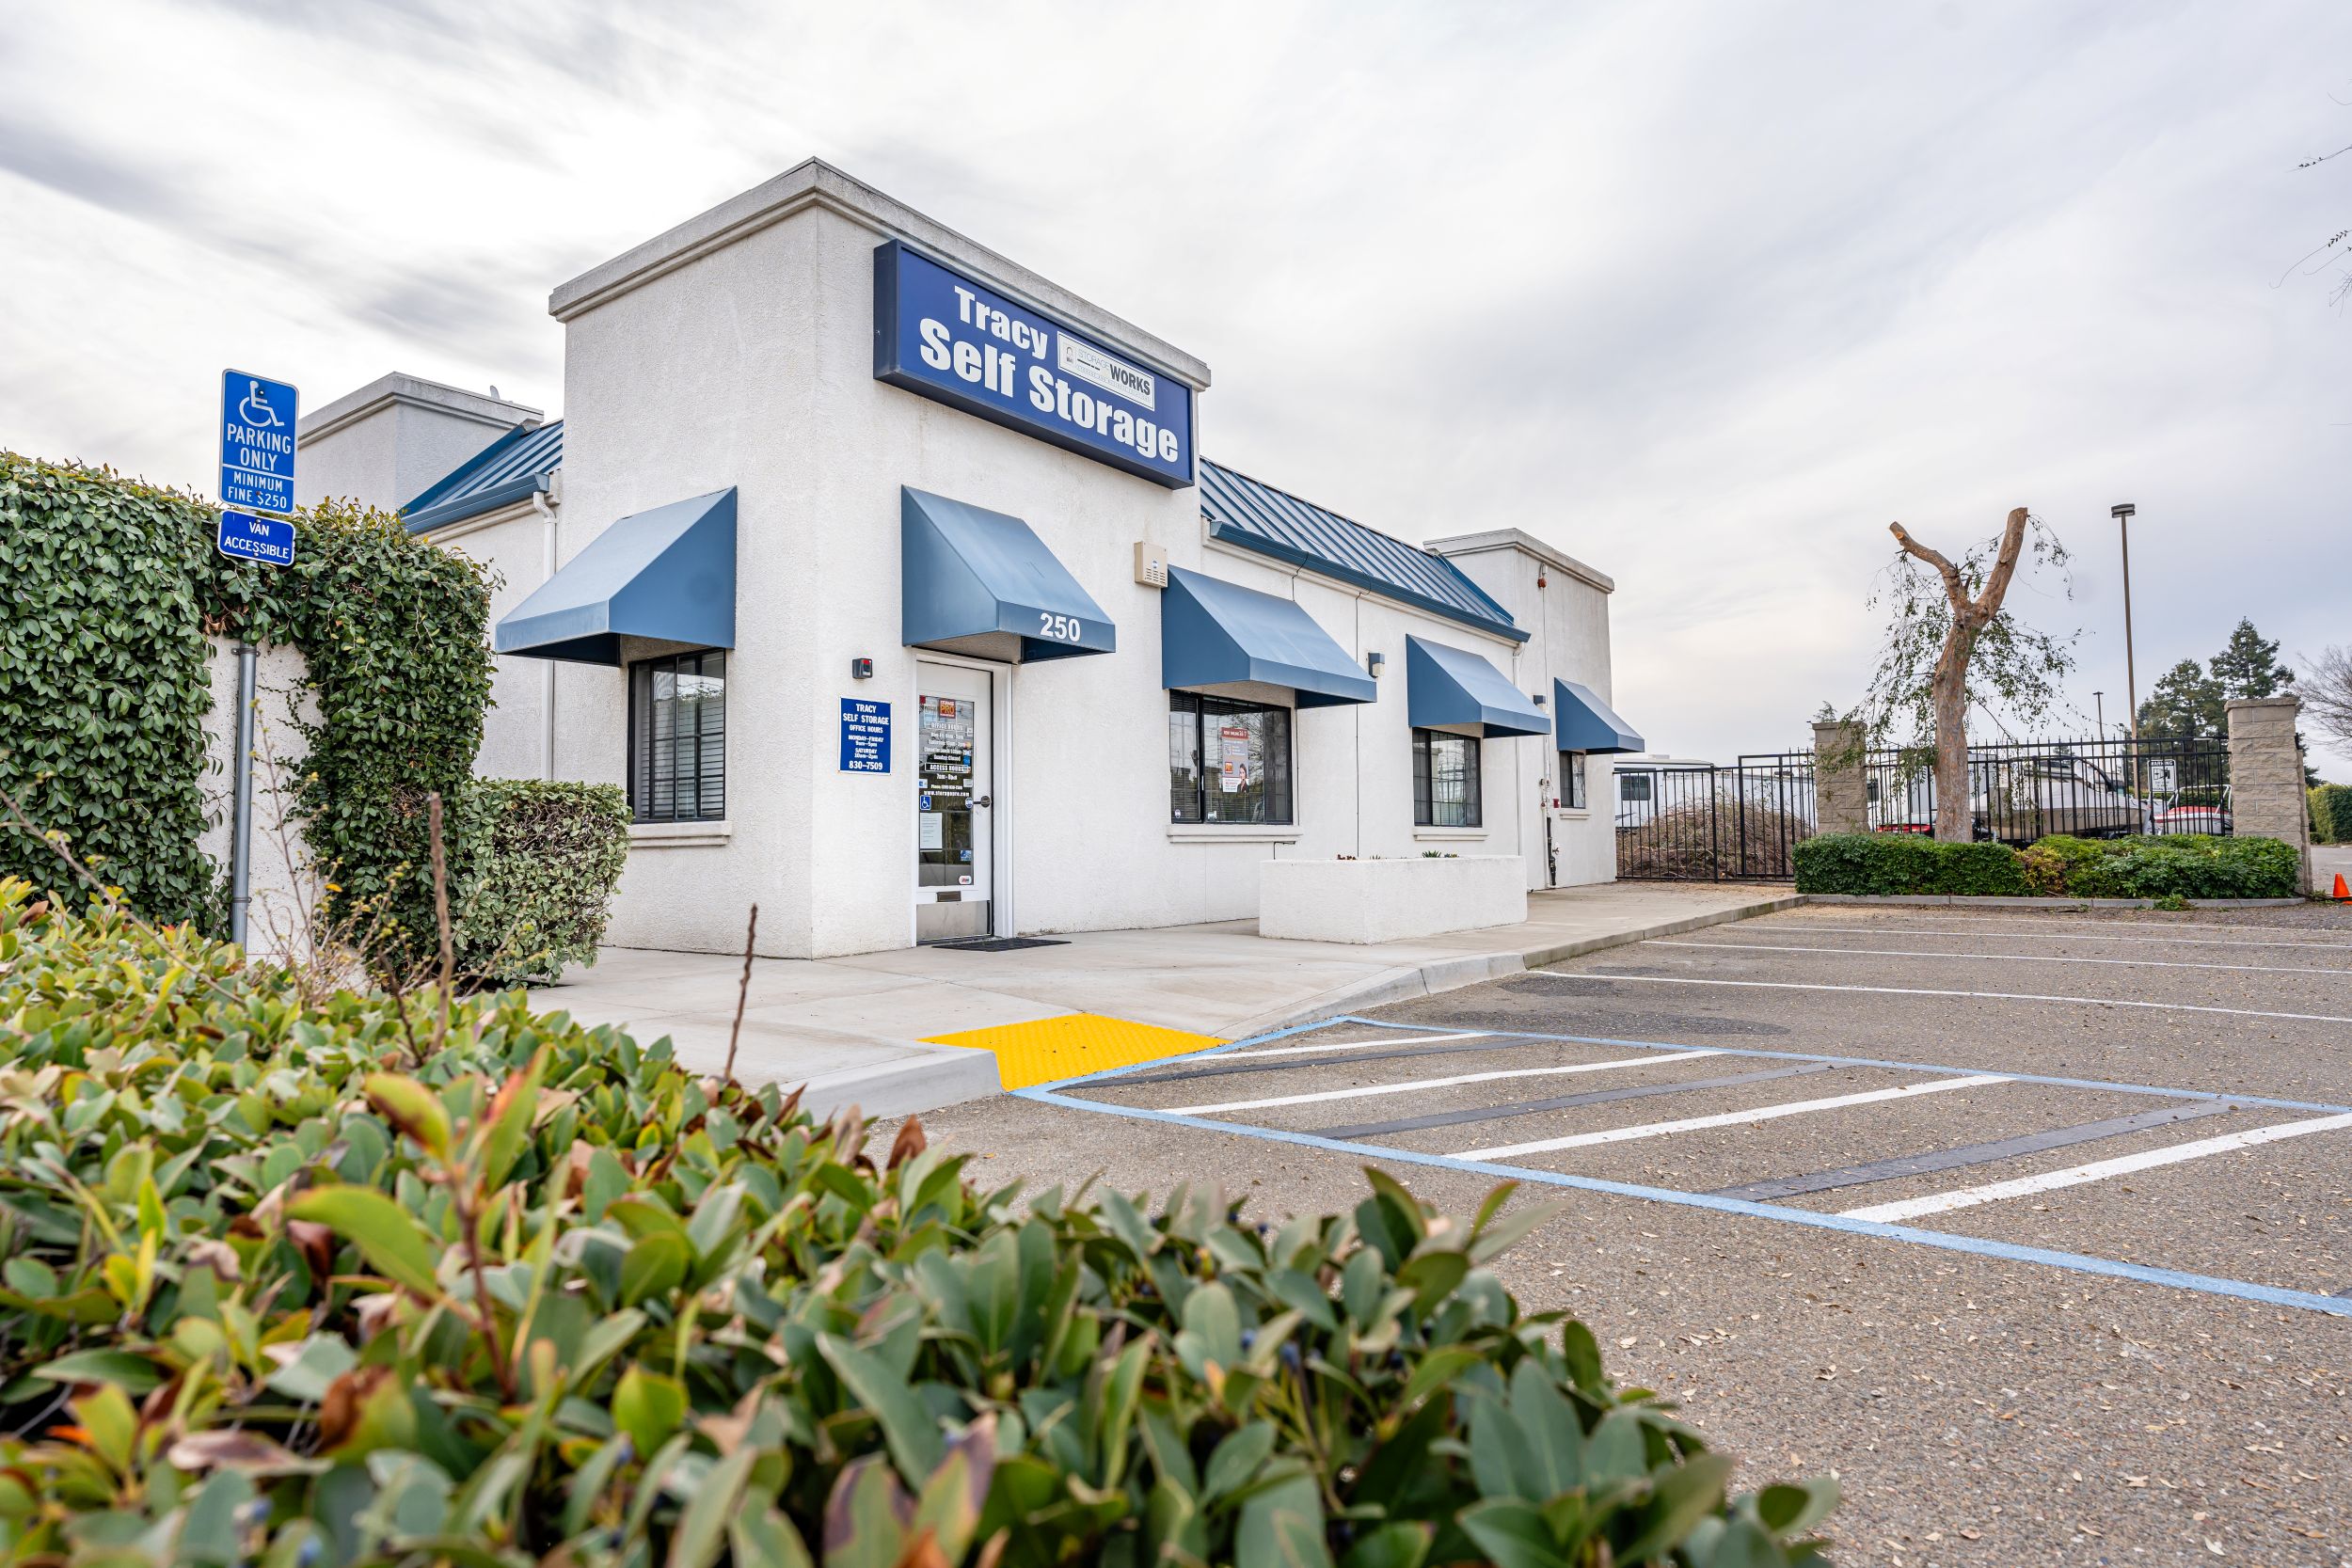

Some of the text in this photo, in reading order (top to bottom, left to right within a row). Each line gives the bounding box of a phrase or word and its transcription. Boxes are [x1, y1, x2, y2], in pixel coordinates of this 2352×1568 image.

[954, 285, 1048, 360] Tracy
[919, 318, 1016, 398] Self
[1028, 365, 1179, 463] Storage
[1110, 364, 1151, 395] WORKS
[227, 422, 292, 454] PARKING
[240, 447, 278, 472] ONLY
[233, 471, 283, 493] MINIMUM
[228, 486, 288, 509] FINE $250
[248, 521, 270, 536] VAN
[224, 535, 290, 560] ACCESSIBLE
[1040, 612, 1081, 642] 250
[842, 712, 889, 725] SELF STORAGE
[855, 703, 877, 714] TRACY
[941, 705, 955, 715] PRO
[866, 725, 883, 734] HOURS
[849, 760, 883, 770] 830-7509
